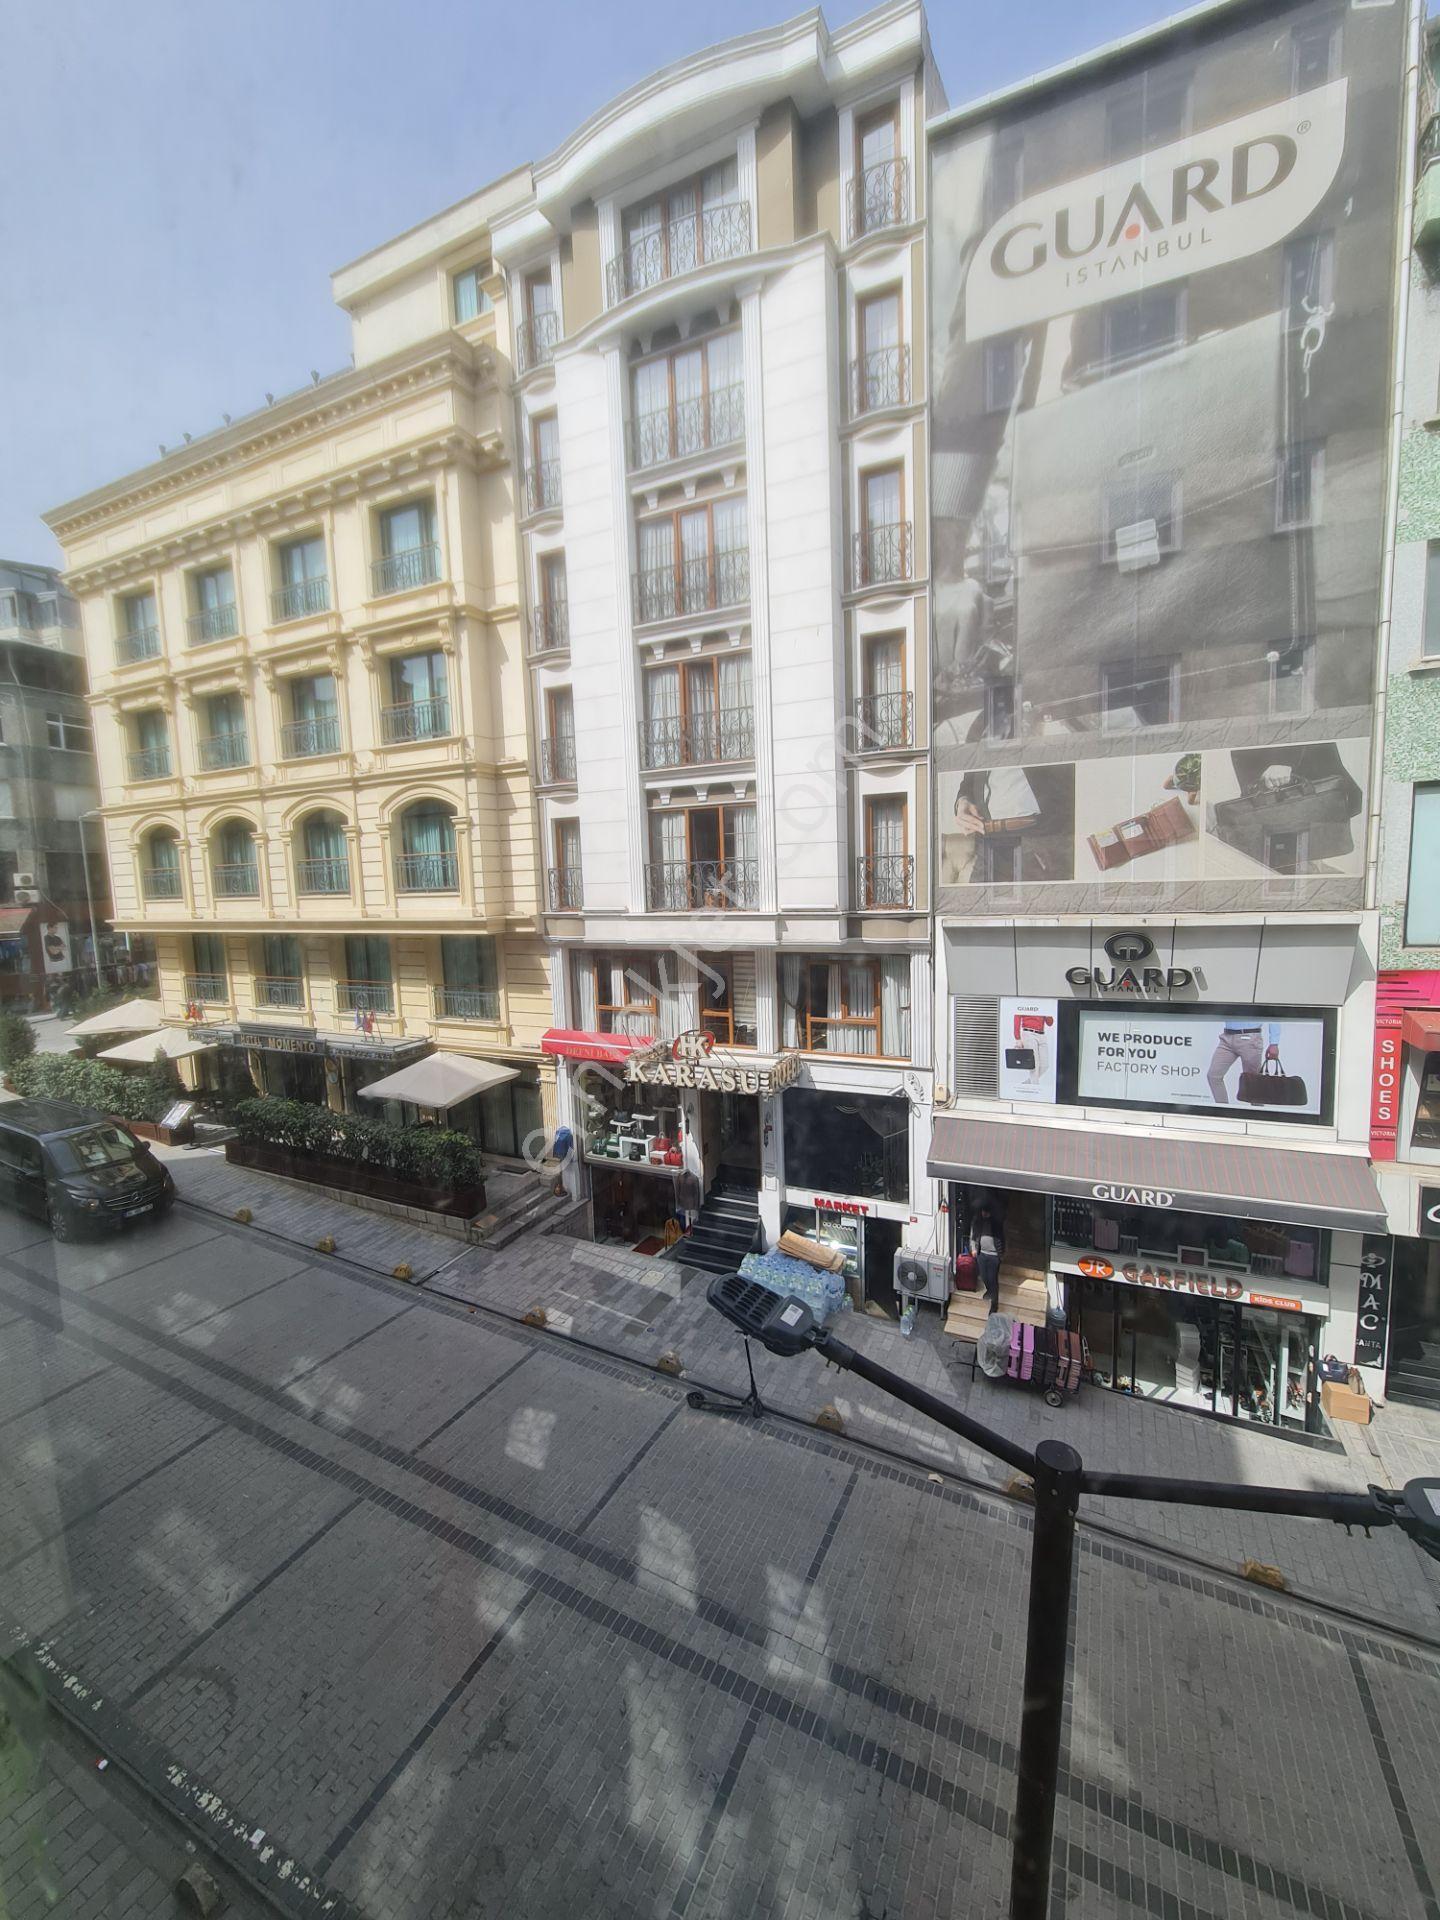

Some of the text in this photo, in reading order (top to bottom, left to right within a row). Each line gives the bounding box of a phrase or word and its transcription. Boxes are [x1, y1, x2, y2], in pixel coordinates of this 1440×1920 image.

[241, 1034, 261, 1046] HOTEL
[268, 1038, 316, 1053] MOMENTO
[681, 1036, 709, 1059] HK
[1098, 1032, 1192, 1046] WE PRODUCE
[1098, 1047, 1157, 1059] FOR YOU
[629, 1060, 761, 1094] KARASU
[1097, 1061, 1200, 1077] FACTORY SHOP
[1378, 1040, 1394, 1120] SHOES
[1092, 1184, 1173, 1207] GUARD
[814, 1198, 869, 1216] MARKET
[1085, 1260, 1243, 1300] JR GARFIELD
[1275, 1300, 1296, 1308] CLUB
